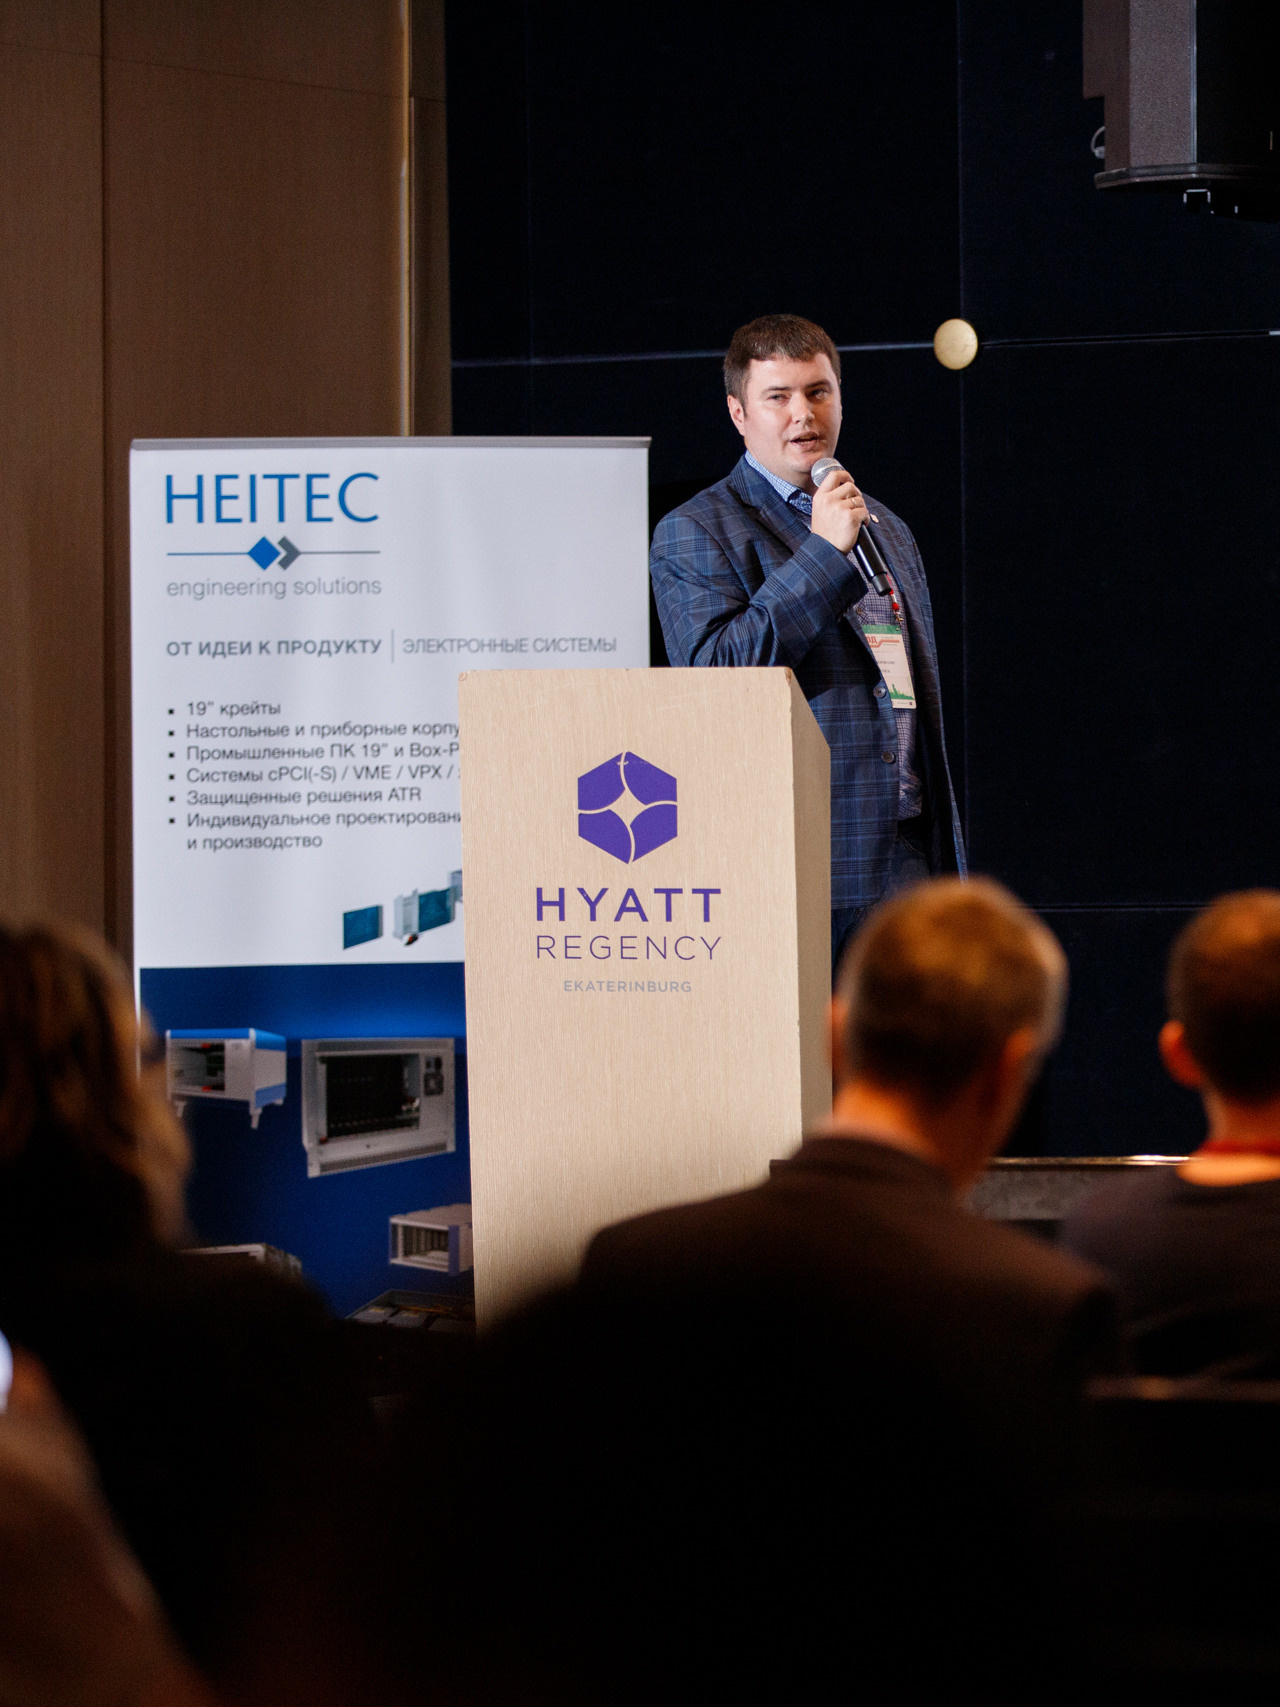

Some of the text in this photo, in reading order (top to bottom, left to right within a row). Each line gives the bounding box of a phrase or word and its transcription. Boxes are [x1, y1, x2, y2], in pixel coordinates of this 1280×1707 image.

[165, 472, 379, 524] HEITEC
[166, 576, 383, 602] engineering solutions
[165, 638, 382, 659] ОТ ИДЕИ К ПРОДУКТУ
[402, 637, 618, 655] ЭЛЕКТРОННЫЕ СИСТЕМЫ
[219, 700, 281, 718] крейты
[186, 723, 290, 739] Настольные
[295, 725, 305, 737] и
[310, 720, 408, 740] приборные
[186, 745, 325, 764] Промышленные
[329, 742, 356, 758] ПК
[393, 746, 404, 758] и
[186, 767, 264, 784] Системы
[266, 765, 337, 783] cPCI(-S)
[352, 764, 390, 780] VME
[407, 764, 442, 780] VPX
[186, 786, 422, 807] Защищенные решения ATR
[186, 811, 331, 830] Индивидуальное
[186, 835, 323, 853] и производство
[536, 887, 722, 923] HYATT
[536, 934, 722, 961] REGENCY
[563, 980, 692, 993] EKATERINBURG
